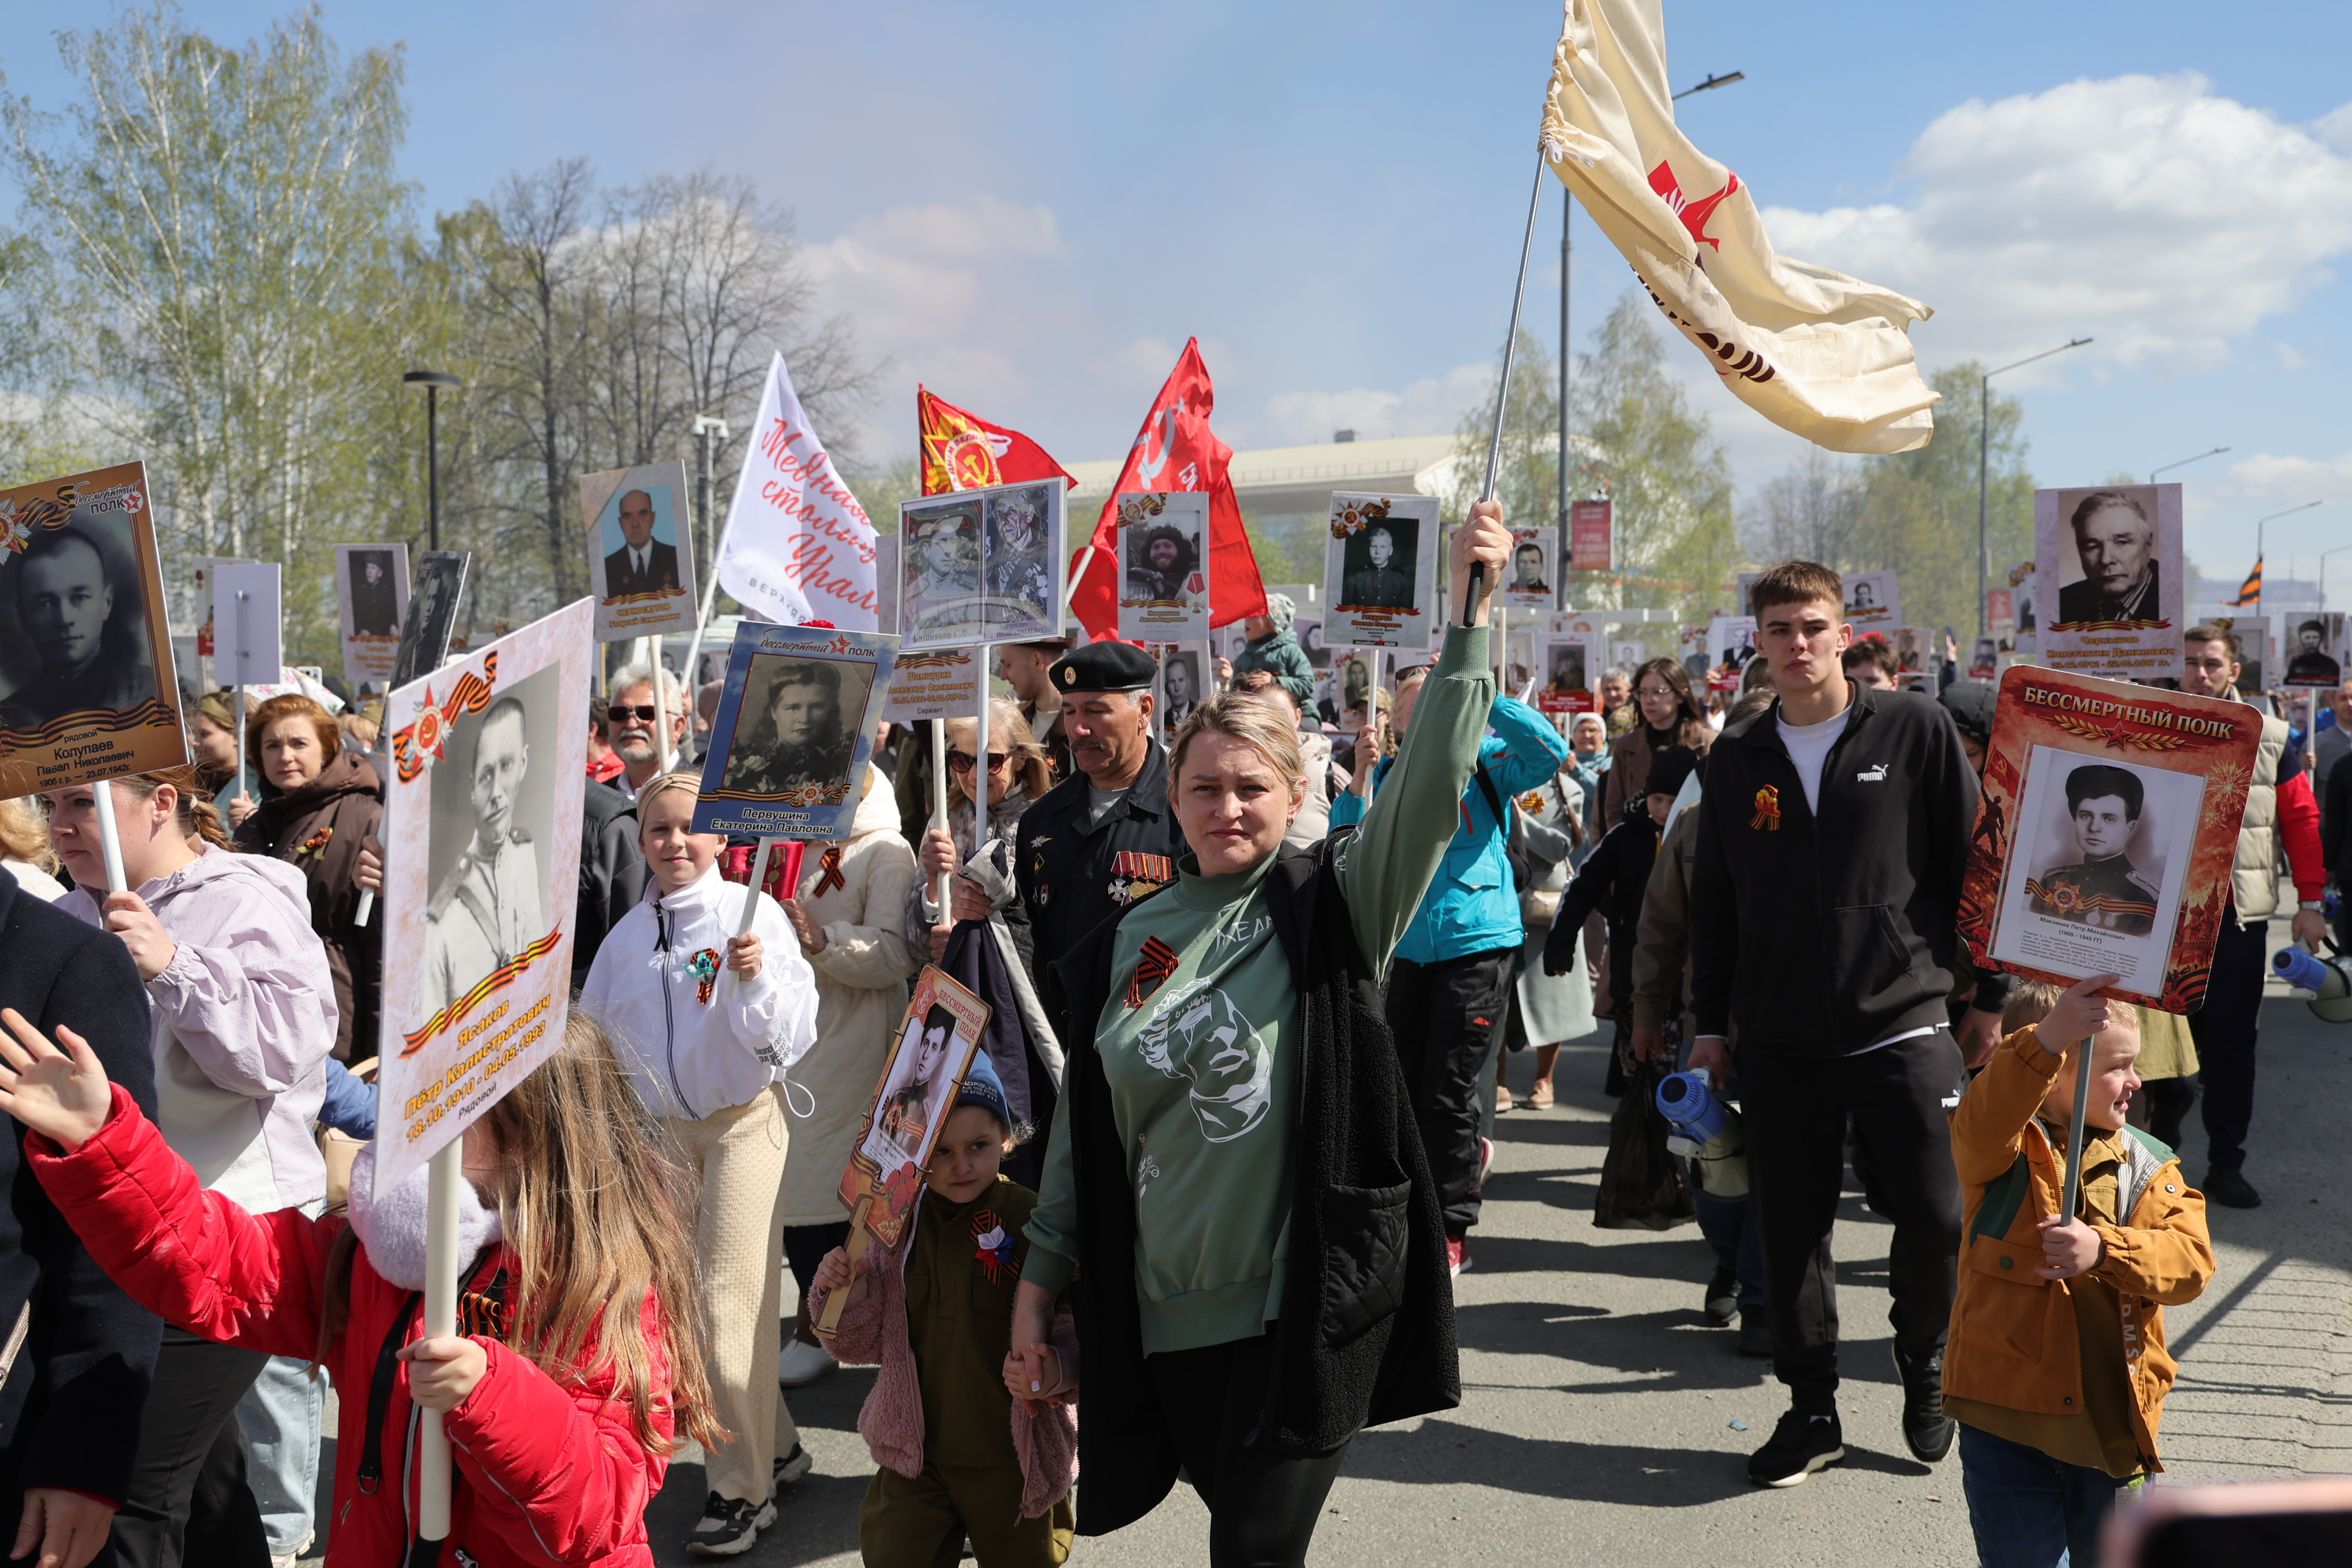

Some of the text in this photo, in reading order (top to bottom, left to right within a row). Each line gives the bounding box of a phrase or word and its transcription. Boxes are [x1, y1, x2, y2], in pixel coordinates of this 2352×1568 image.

[73, 479, 141, 505] бессмертный
[90, 497, 126, 515] ПОЛК
[763, 480, 876, 564] столиц
[785, 533, 880, 616] Урал
[760, 628, 876, 658] бессмертный ПОЛК
[2081, 635, 2139, 646] Чернышов
[2046, 647, 2175, 659] Константин Данилович
[907, 671, 952, 681] Шамшурин
[927, 682, 974, 692] Филиппович
[2024, 686, 2234, 740] БЕССМЕРТНЫЙ ПОЛК
[63, 729, 98, 744] рядовой
[54, 740, 115, 761] Колупаев
[36, 750, 134, 776] Павел Николаевич
[40, 777, 58, 788] 1905
[1857, 771, 1883, 782] PUMA
[742, 807, 810, 822] Первушина
[711, 819, 833, 835] Екатерина Павловна
[2039, 916, 2125, 941] Маковеев Петр Михайлович
[938, 989, 983, 1028] БЕССМЕРТНЫЙ
[457, 999, 510, 1050] Ясаков
[959, 1020, 978, 1041] ПОЛК
[405, 993, 551, 1119] Пётр Калистратович
[407, 1077, 475, 1143] 18.10.1910
[484, 1020, 546, 1079] 04.05.1993
[458, 1081, 497, 1121] Рядовой
